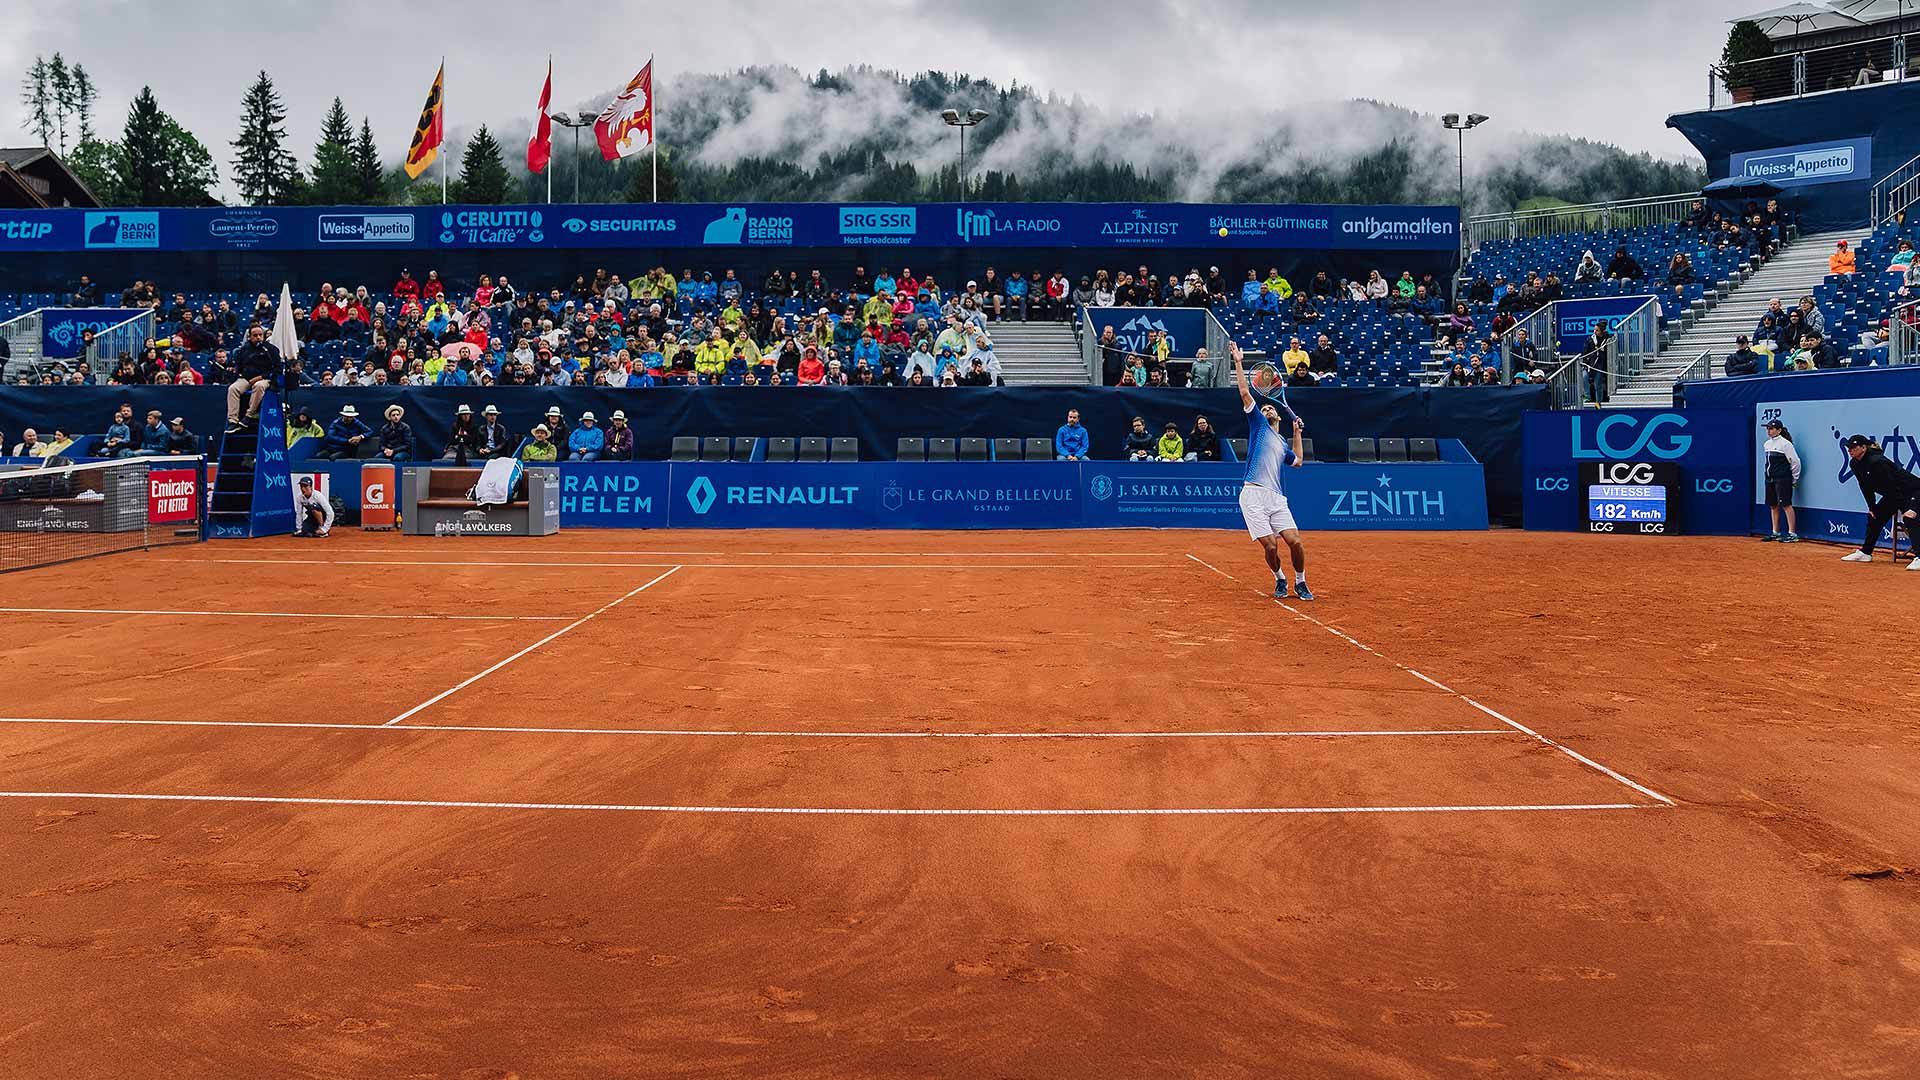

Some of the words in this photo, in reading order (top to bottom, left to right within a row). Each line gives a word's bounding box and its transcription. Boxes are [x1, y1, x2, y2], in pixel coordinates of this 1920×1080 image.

[1749, 156, 1848, 177] Weiss+Appetito
[457, 211, 528, 227] CERUTTI
[590, 219, 677, 231] SECURITAS
[749, 217, 793, 228] RADIO
[844, 213, 876, 228] SRG
[880, 213, 911, 228] SSR
[995, 219, 1013, 232] LA
[1017, 219, 1061, 232] RADIO
[1342, 216, 1453, 234] anthamatten
[122, 223, 156, 232] RADIO
[211, 223, 276, 231] Laurent-Perrier
[323, 221, 410, 237] Weiss+Appetito
[1101, 222, 1179, 234] ALPINIST
[844, 236, 862, 244] Host
[864, 236, 911, 244] Broadcaster
[1565, 321, 1584, 331] RTS
[1761, 408, 1782, 420] ATP
[1572, 413, 1692, 459] LCG
[1599, 463, 1654, 484] LCG
[151, 479, 194, 498] Emirates
[1535, 477, 1570, 491] LCG
[1695, 478, 1734, 493] LCG
[727, 486, 859, 504] RENAULT
[909, 489, 925, 501] LE
[932, 489, 990, 501] GRAND
[996, 489, 1073, 501] BELLEVUE
[1118, 485, 1127, 498] J.
[1132, 485, 1179, 496] SAFRA
[1603, 487, 1651, 497] VITESSE
[157, 499, 168, 514] FLY
[168, 497, 188, 513] BETTER
[1329, 490, 1444, 515] ZENITH
[1596, 503, 1626, 519] 182
[1631, 509, 1661, 519] Km/h
[1590, 521, 1614, 532] LCG
[1640, 522, 1664, 533] LCG
